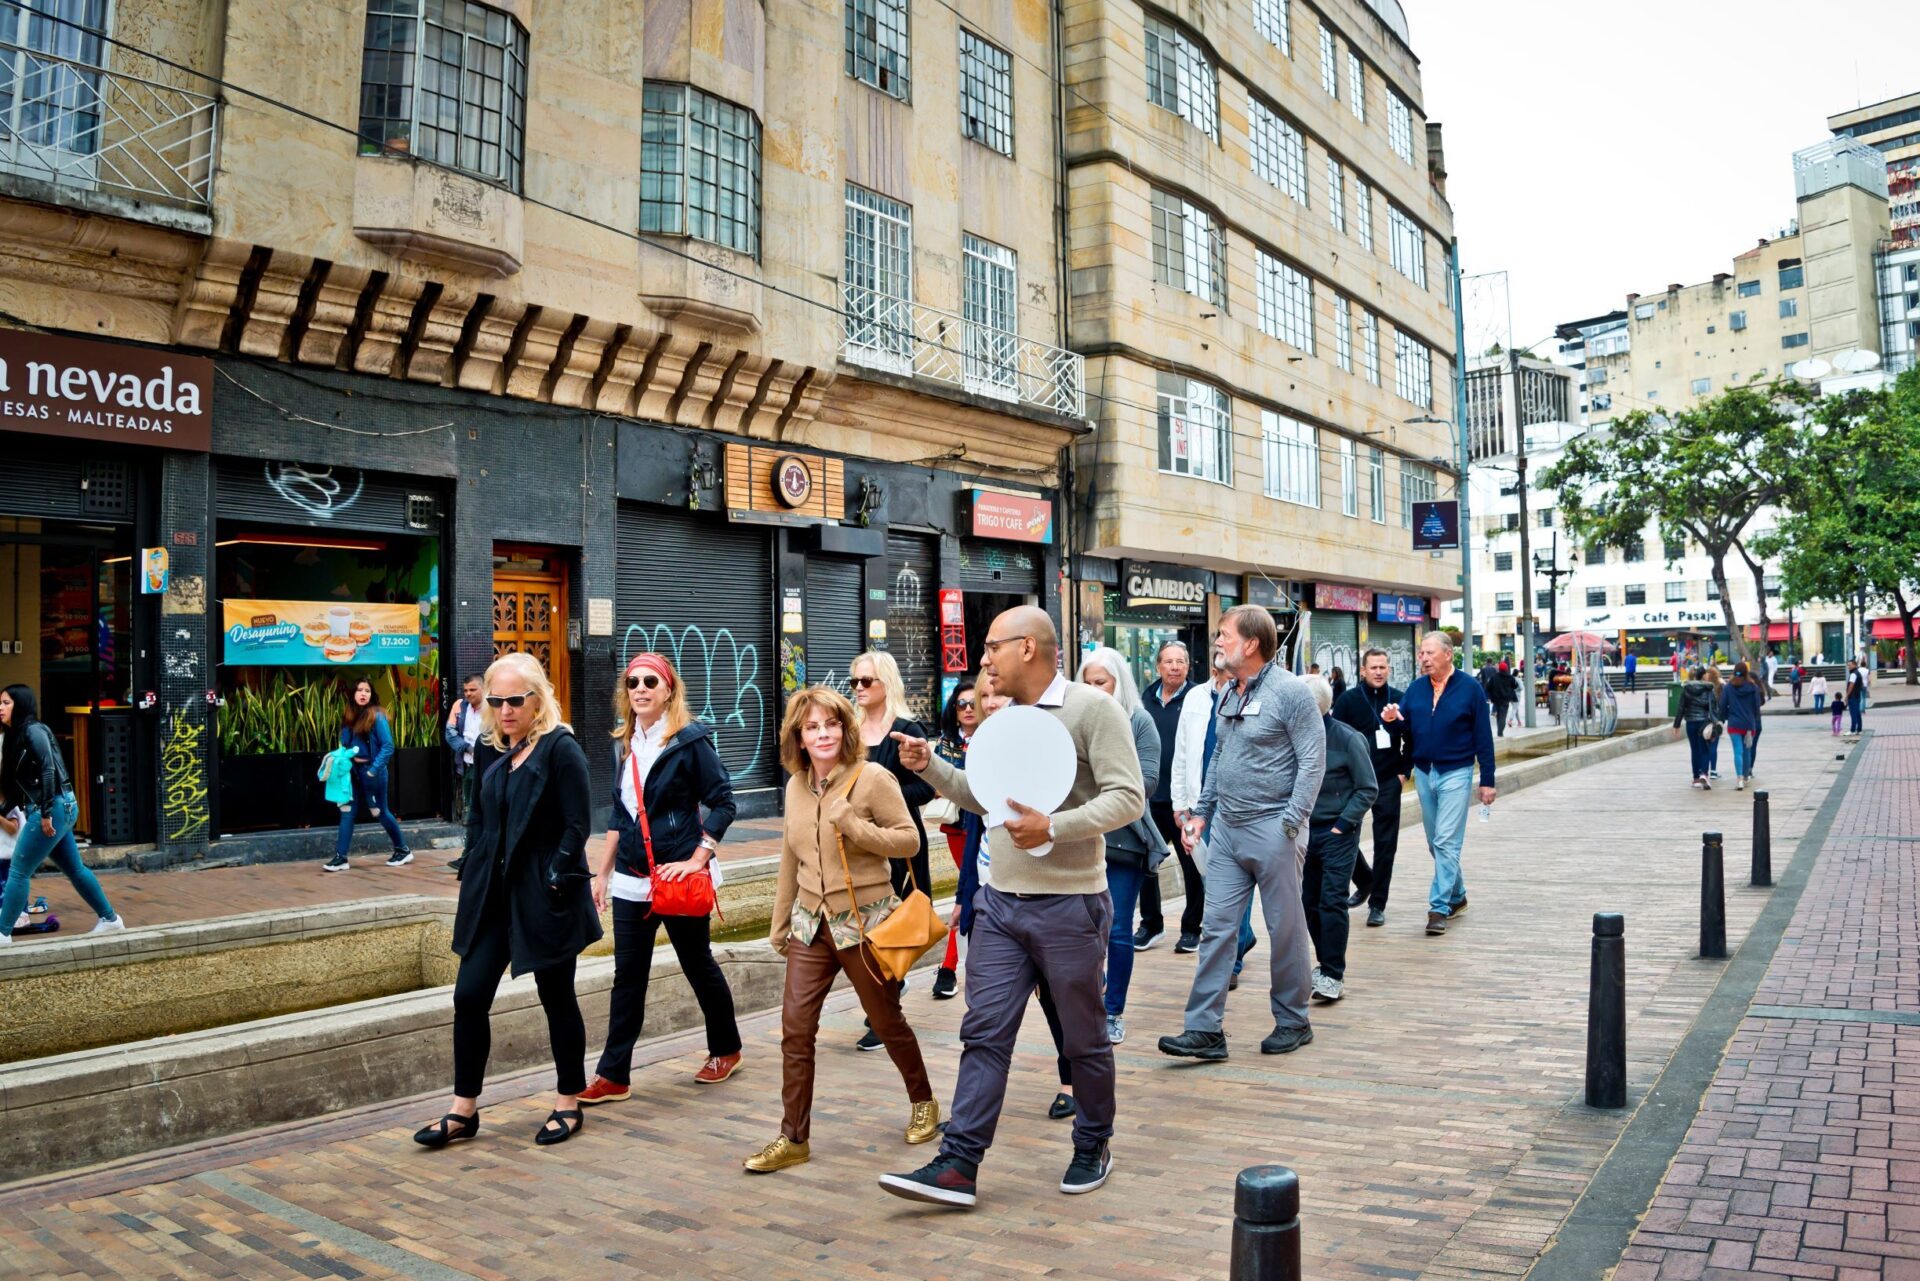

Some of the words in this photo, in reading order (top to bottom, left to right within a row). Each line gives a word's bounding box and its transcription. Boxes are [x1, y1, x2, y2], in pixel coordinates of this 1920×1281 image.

[25, 360, 203, 416] nevada
[1, 400, 50, 420] ESAS
[67, 408, 173, 434] MALTEADAS
[976, 513, 999, 527] TRIGO
[998, 516, 1005, 529] Y
[1127, 575, 1205, 602] CAMBIOS
[1643, 611, 1669, 623] Café
[1678, 610, 1717, 622] Pasaje
[230, 621, 297, 643] Desayuning
[381, 636, 411, 647] $7.200
